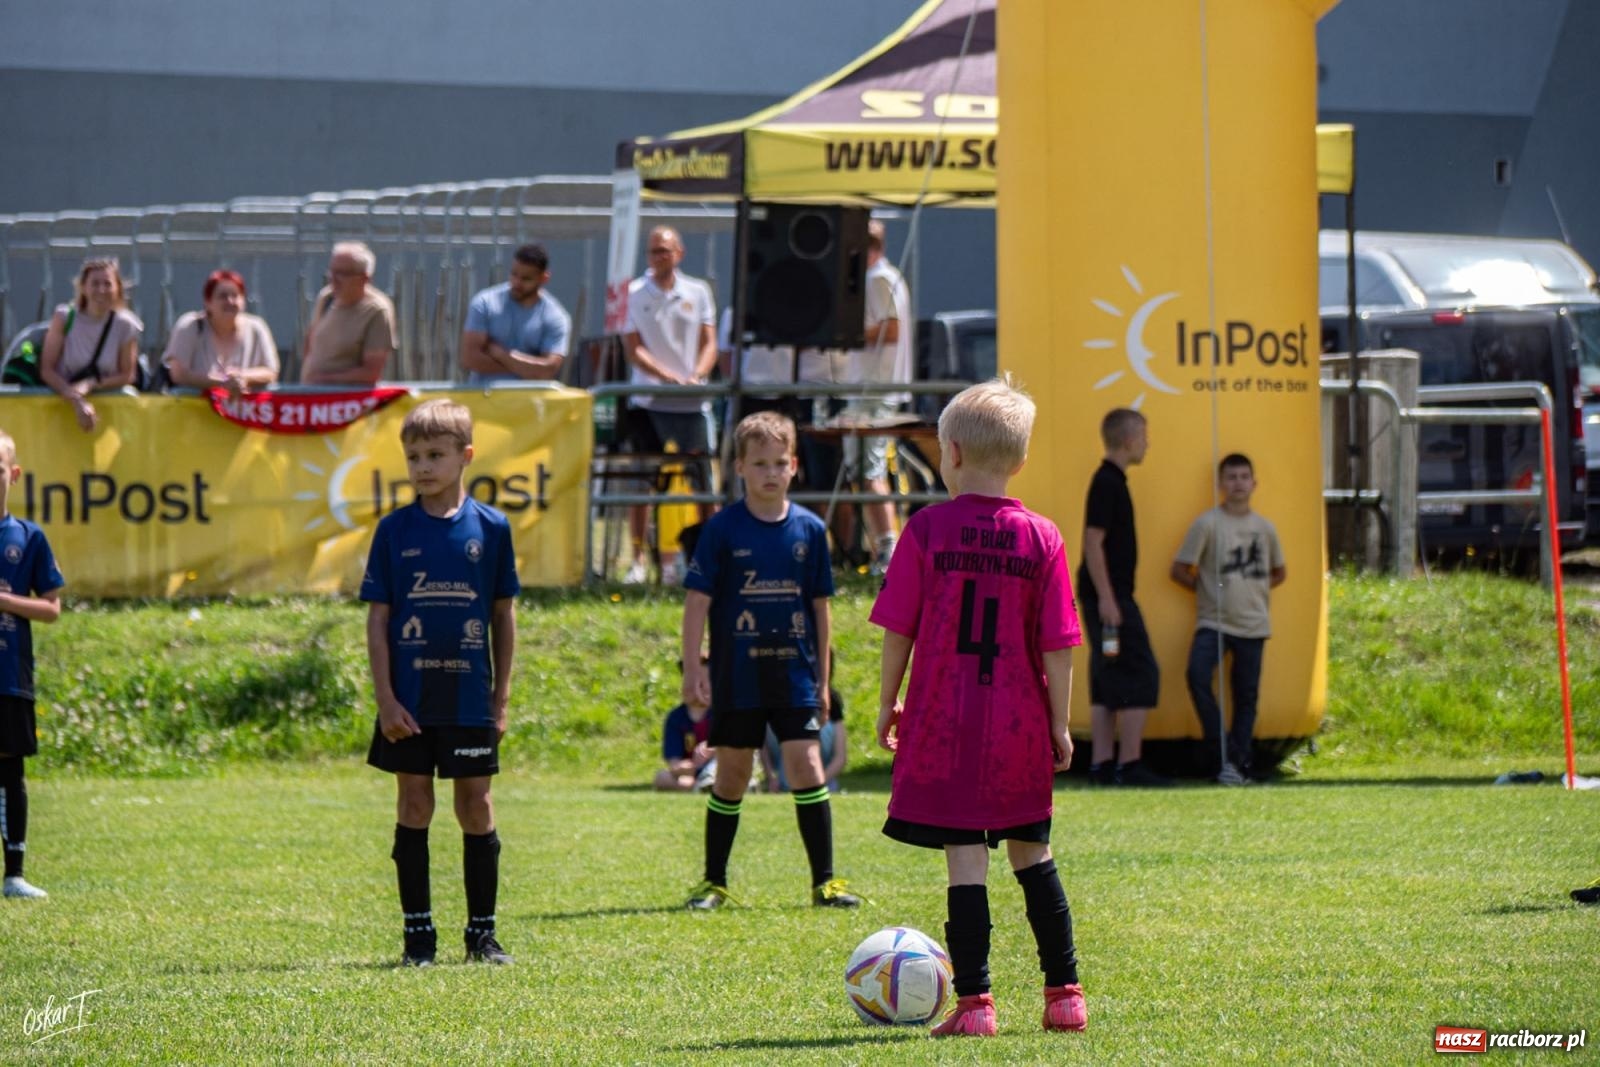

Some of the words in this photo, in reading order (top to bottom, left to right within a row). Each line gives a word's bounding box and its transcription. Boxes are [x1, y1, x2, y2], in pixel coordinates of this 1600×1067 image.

[1177, 321, 1308, 367] InPost
[1192, 379, 1227, 392] out
[1232, 379, 1251, 392] of
[1257, 380, 1283, 392] the
[1287, 380, 1307, 392] box
[280, 402, 305, 424] 21
[25, 472, 210, 524] InPost
[373, 463, 553, 515] Inost
[957, 580, 999, 686] 4
